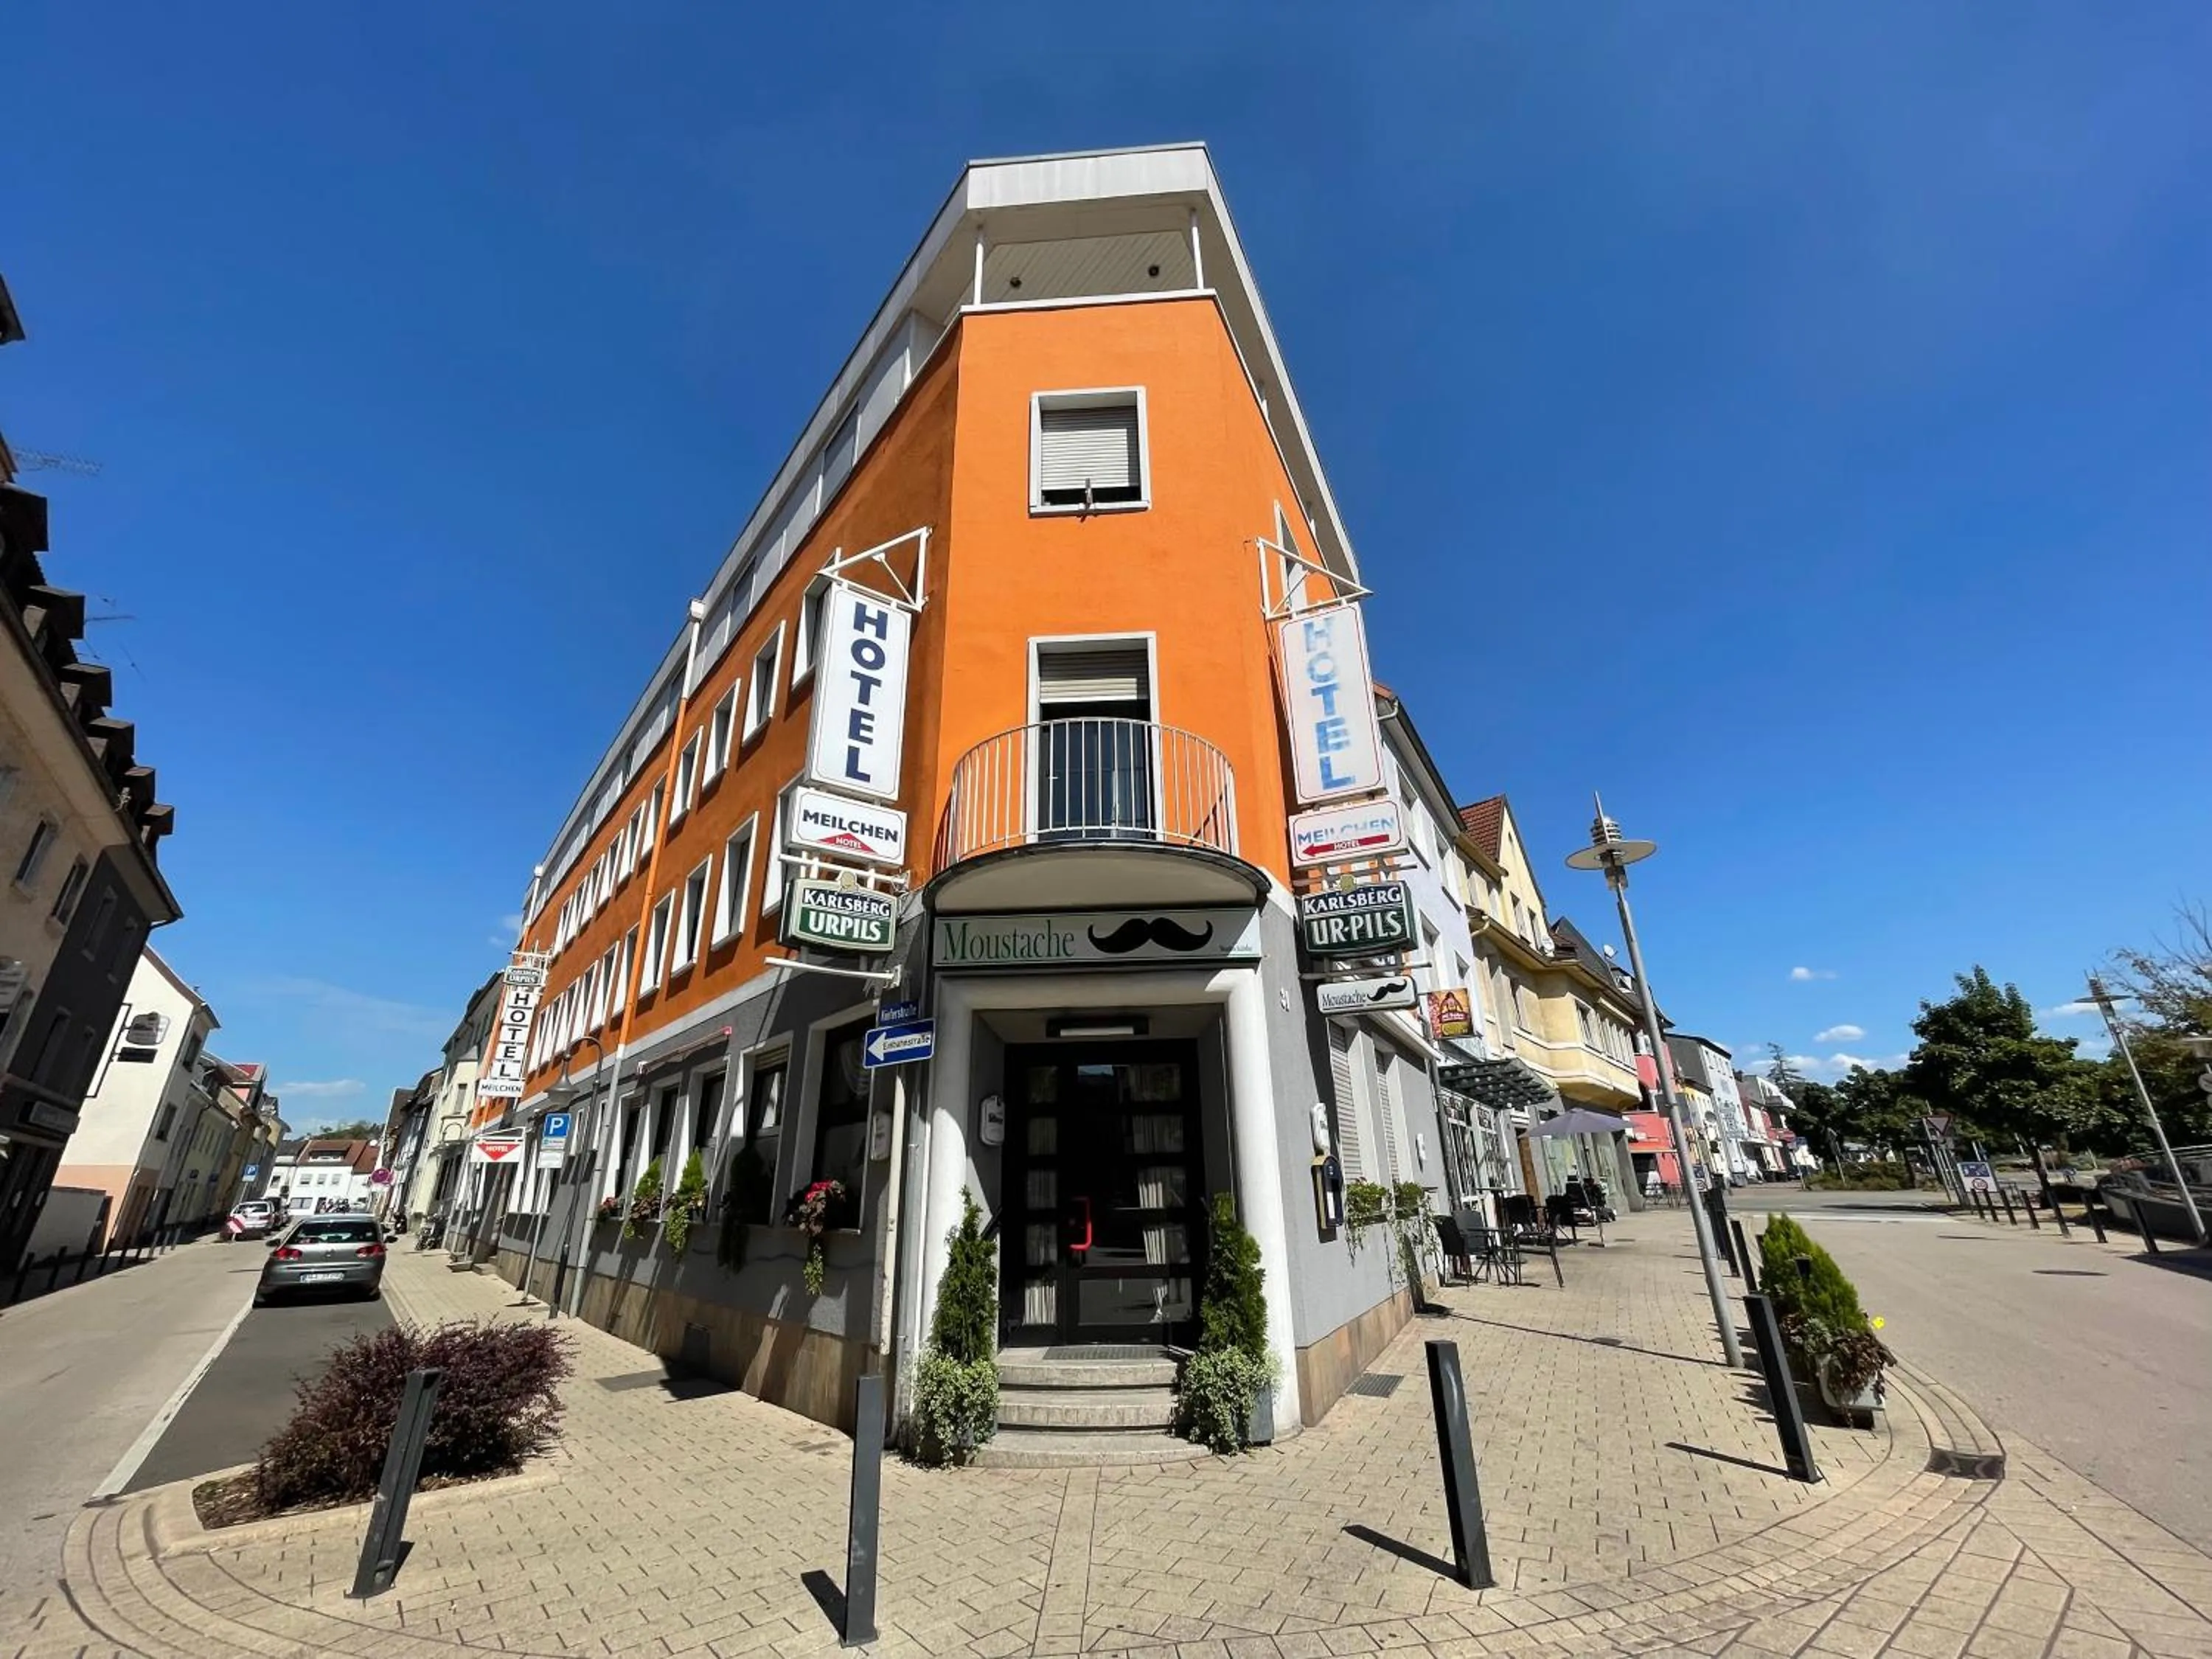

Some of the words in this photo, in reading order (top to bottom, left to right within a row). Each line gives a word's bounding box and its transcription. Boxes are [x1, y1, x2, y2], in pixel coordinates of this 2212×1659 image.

[845, 601, 888, 783] HOTEL
[1302, 617, 1356, 790] HOTEL
[802, 809, 899, 843] MEILCHEN
[835, 836, 862, 849] HOTEL
[1334, 840, 1360, 850] HOTEL
[803, 888, 891, 918] KARLSBERG
[1303, 886, 1402, 916] KARLSBERG
[808, 911, 882, 942] URPILS
[943, 919, 1075, 960] Moustache
[1322, 988, 1367, 1007] Moustache
[499, 992, 529, 1077] HOTEL
[549, 1117, 564, 1135] P
[485, 1144, 508, 1152] HOTEL
